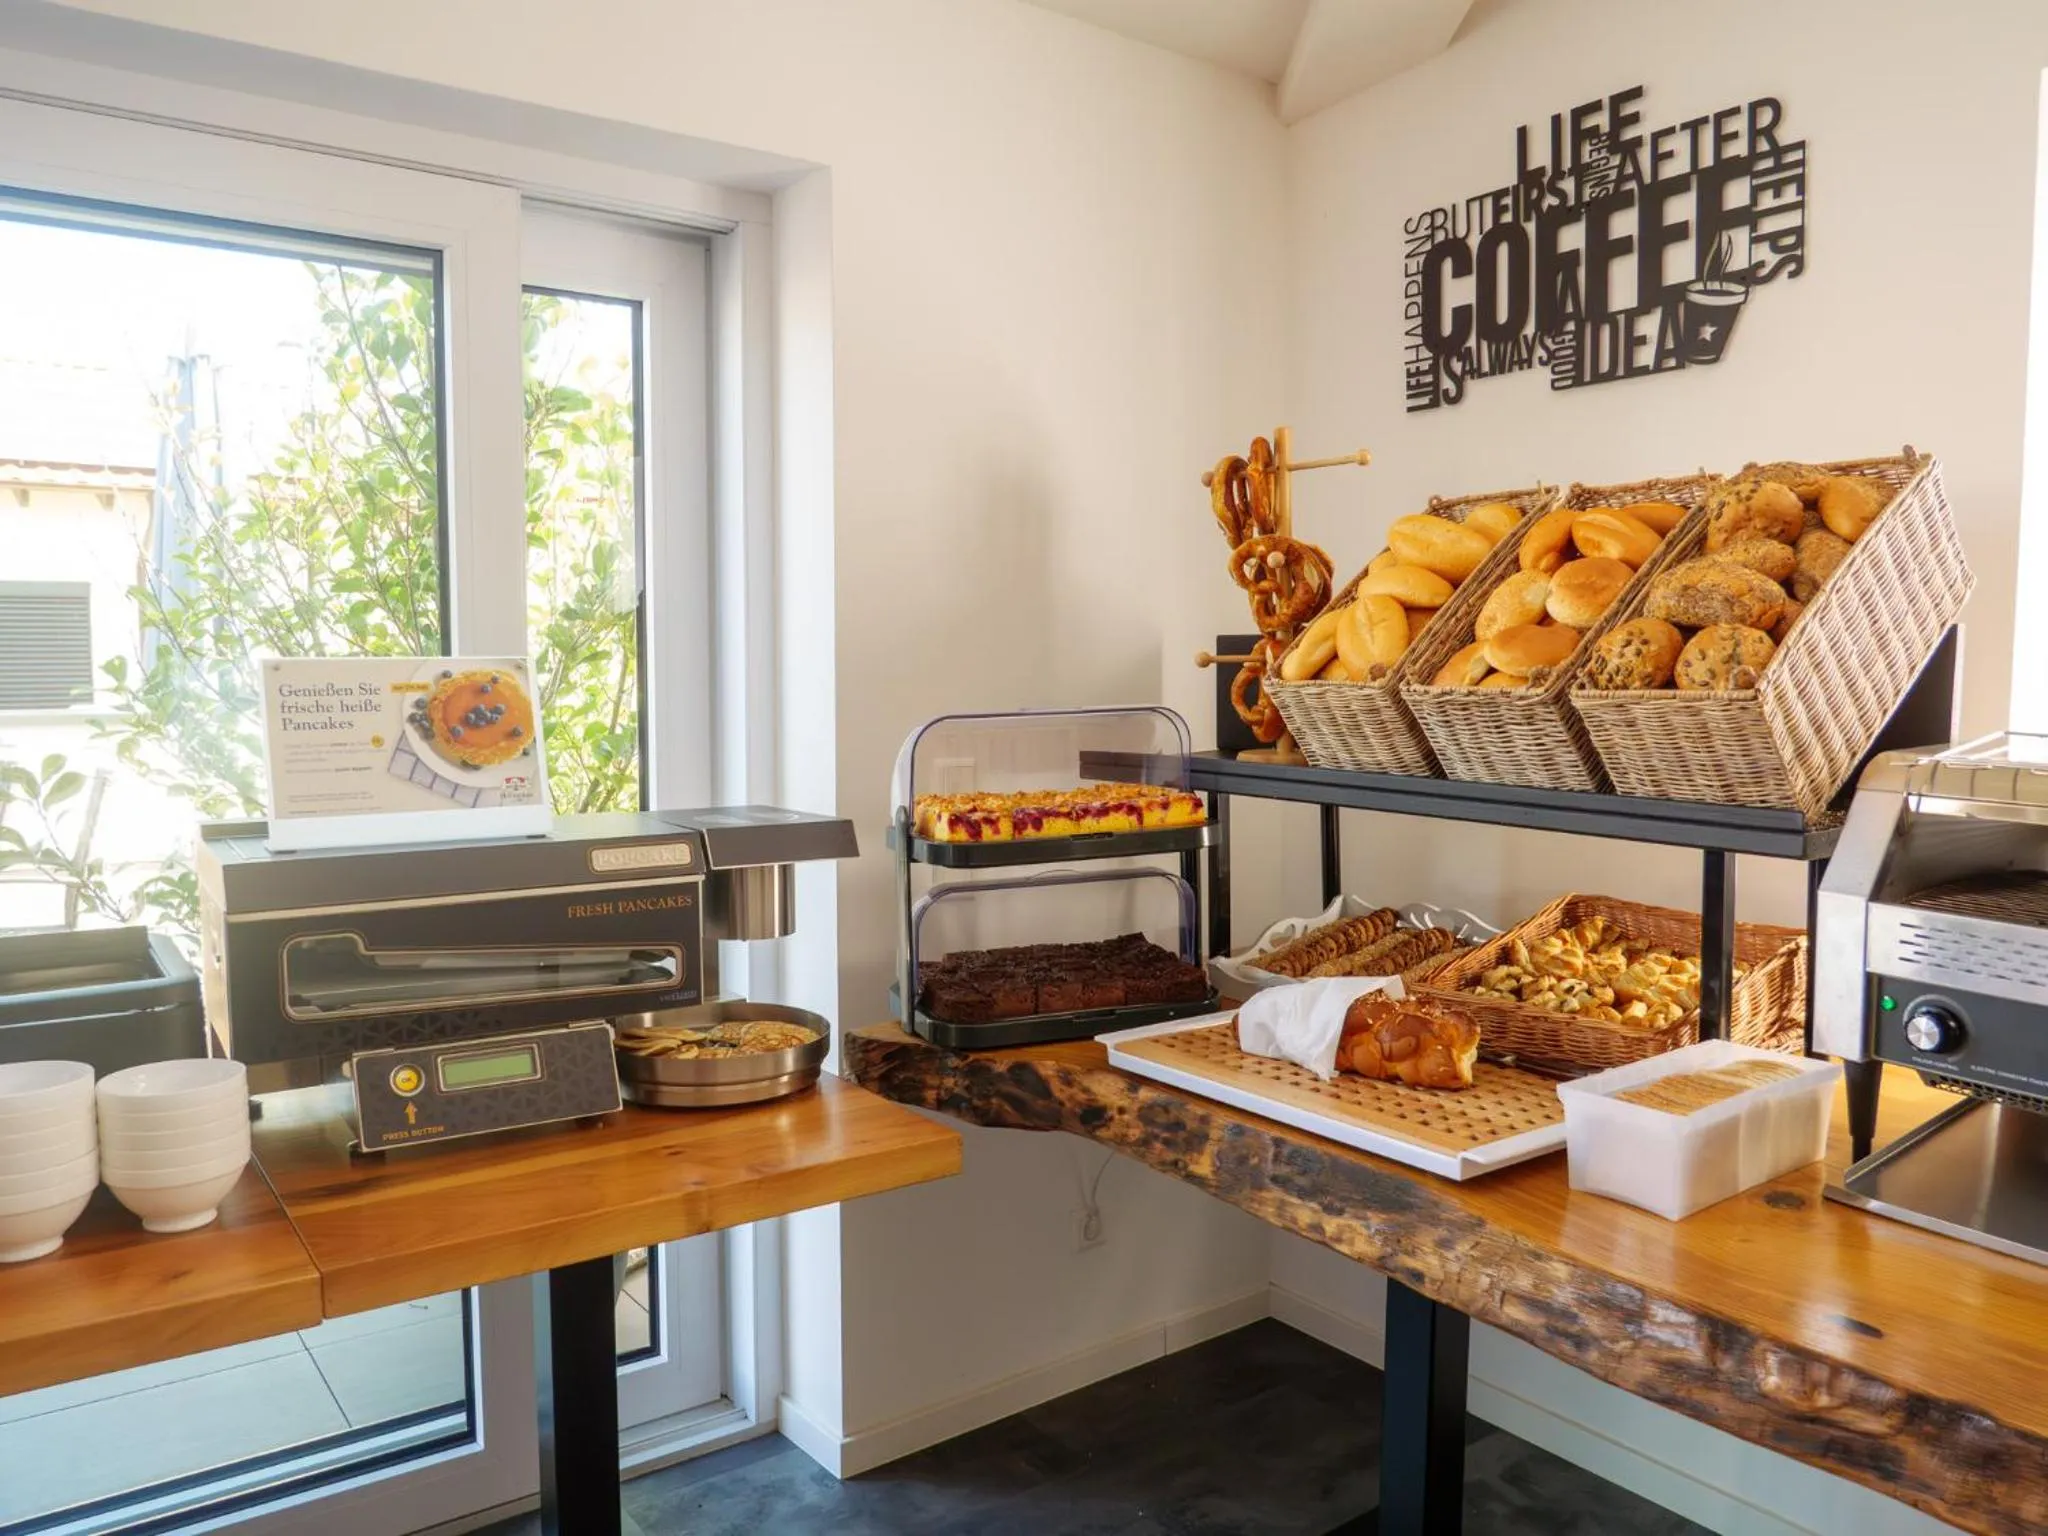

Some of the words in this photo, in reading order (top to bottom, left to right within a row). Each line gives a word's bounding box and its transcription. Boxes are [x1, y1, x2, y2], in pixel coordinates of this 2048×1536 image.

[1516, 85, 1643, 182] LIFE
[1588, 128, 1611, 200] BEGINS
[1611, 97, 1782, 192] AFTER
[1430, 191, 1492, 243] BUT
[1491, 164, 1589, 227] FIRST
[1750, 139, 1806, 286] HELPS
[1422, 150, 1752, 354] COFFEE
[1404, 210, 1434, 366] HAPPENS
[1459, 330, 1553, 380] ALWAYS
[1550, 329, 1577, 391] GOOD
[1576, 300, 1687, 387] IDEA
[1405, 359, 1441, 413] LIFE
[278, 682, 354, 698] Genießen
[358, 682, 382, 696] Sie
[280, 699, 335, 714] frische
[339, 698, 383, 713] heiße
[281, 716, 355, 731] Pancakes
[567, 902, 614, 918] FRESH
[618, 895, 693, 913] PANCAKES
[382, 1131, 409, 1141] PRESS
[411, 1125, 444, 1136] BUTTON
